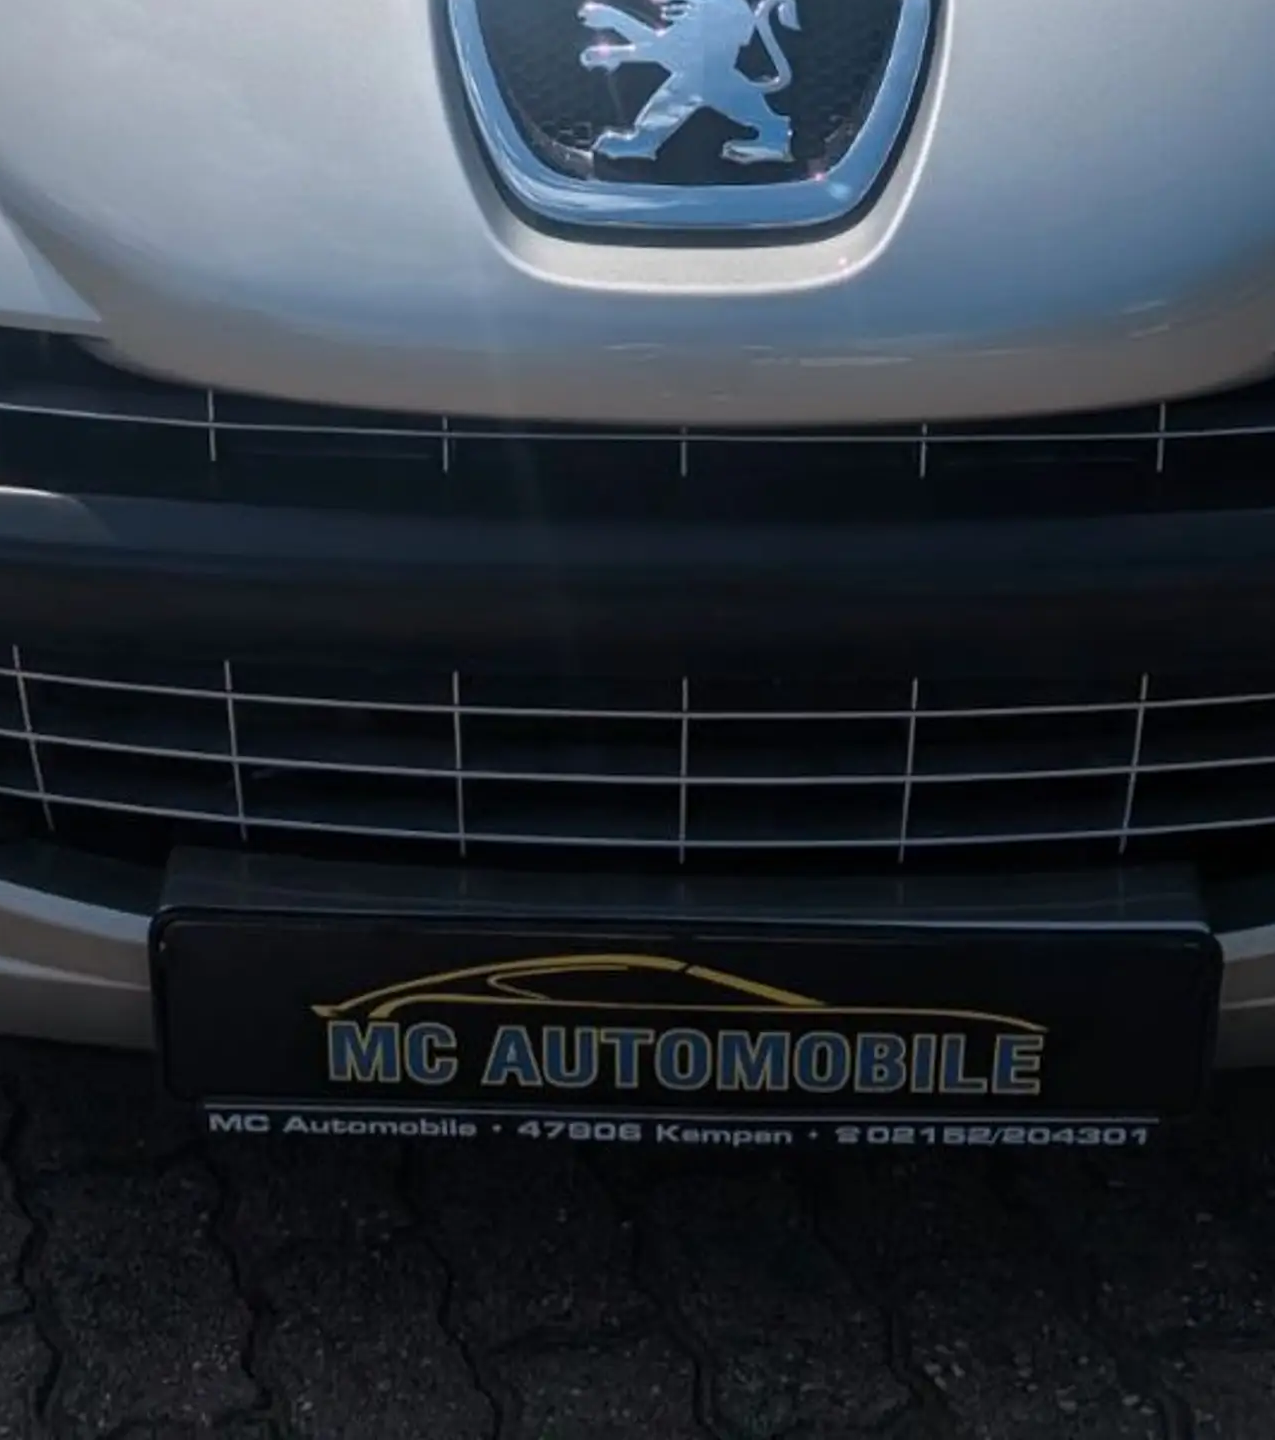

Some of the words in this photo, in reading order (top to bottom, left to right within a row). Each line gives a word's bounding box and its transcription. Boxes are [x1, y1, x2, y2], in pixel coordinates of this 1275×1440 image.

[327, 1019, 459, 1084] MC
[482, 1023, 1044, 1095] AUTOMOBILE
[208, 1113, 271, 1133] MC
[282, 1114, 478, 1138] Automobile
